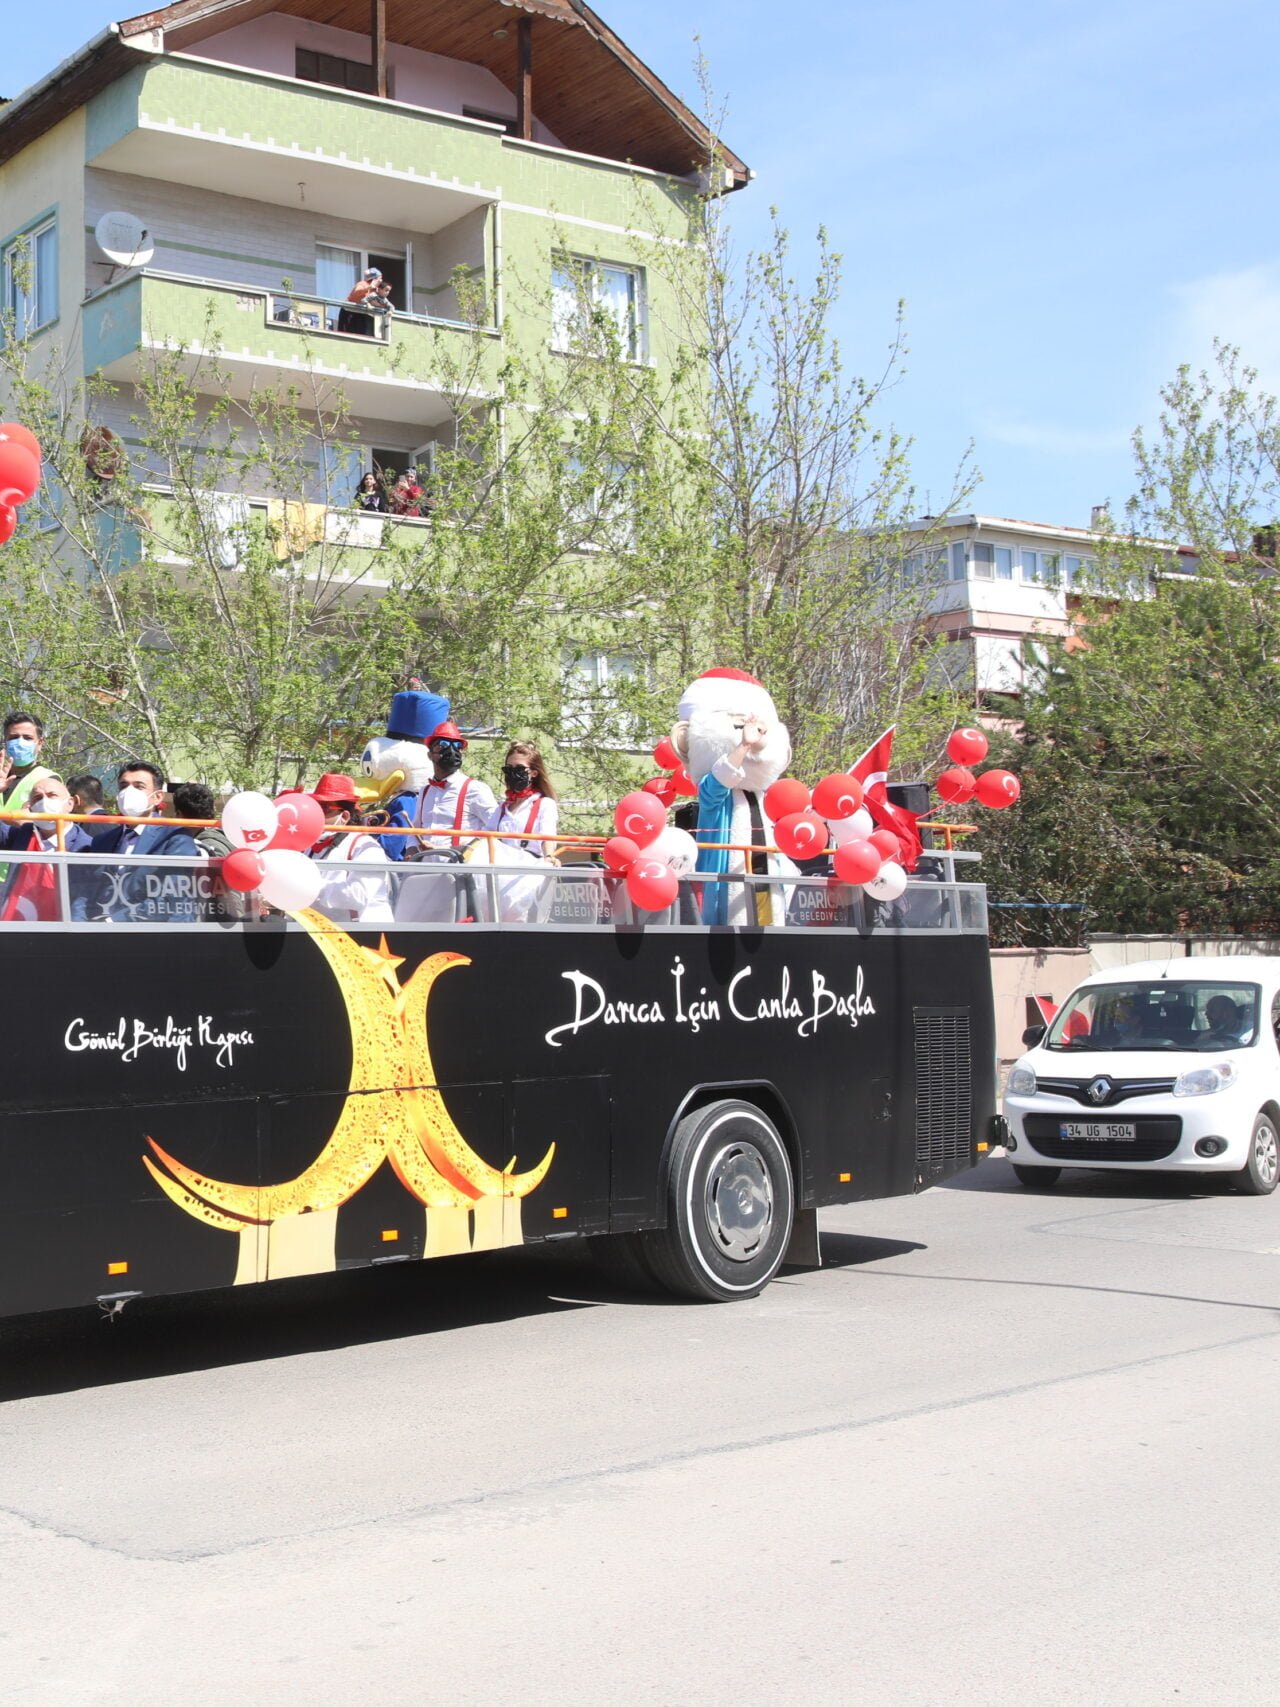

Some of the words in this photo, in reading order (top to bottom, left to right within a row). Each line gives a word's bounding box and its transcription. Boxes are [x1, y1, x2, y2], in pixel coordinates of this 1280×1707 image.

[145, 875, 226, 899] DARICA
[671, 955, 720, 1033] İçin
[728, 965, 803, 1022] Canla
[798, 965, 876, 1037] Başla
[64, 1017, 126, 1051] Gönül
[122, 1016, 193, 1071] Birliği
[1068, 1125, 1081, 1136] 34
[1086, 1125, 1100, 1137] UG
[1106, 1125, 1132, 1137] 1504
